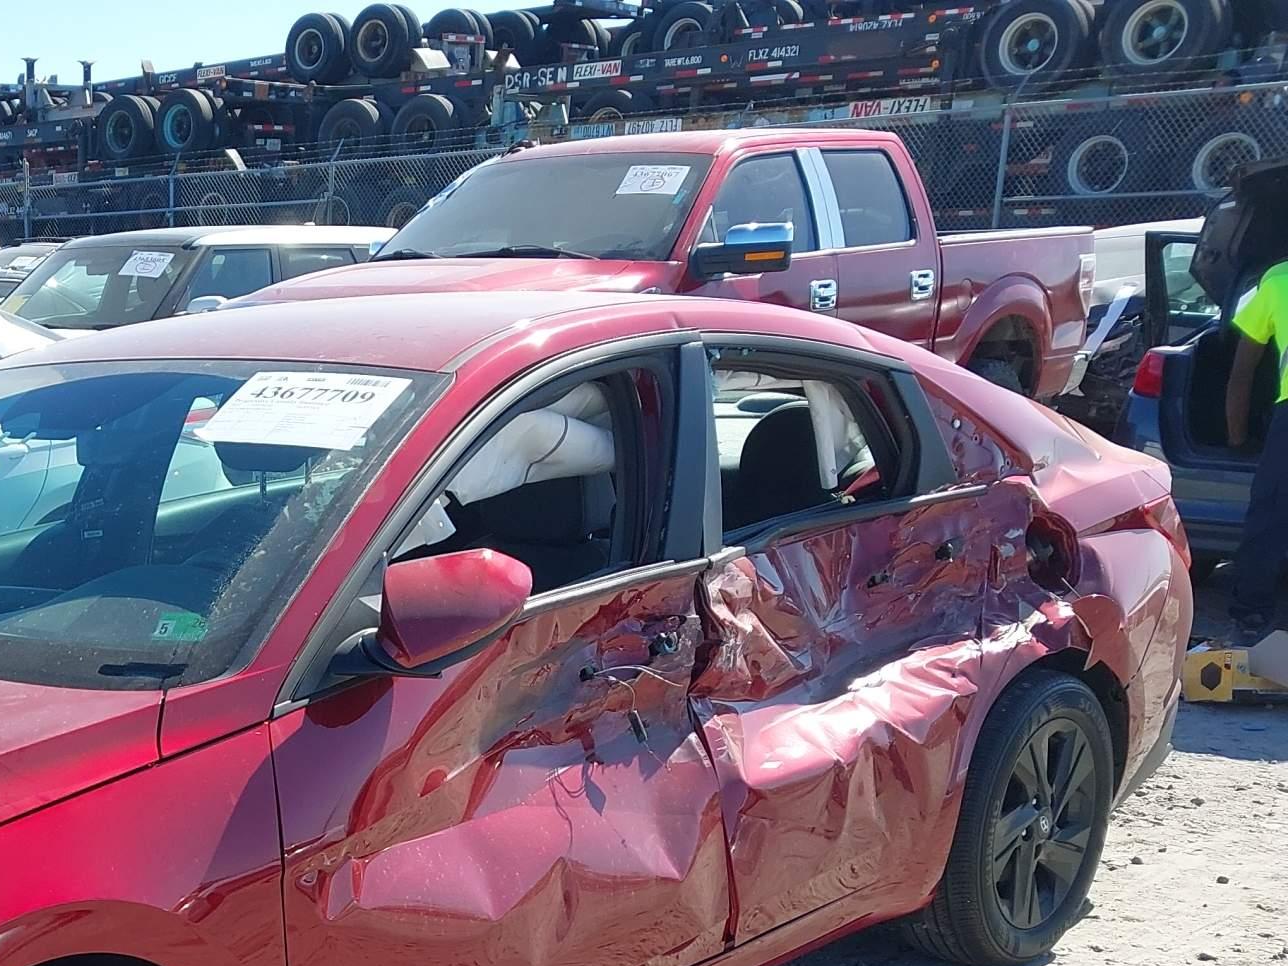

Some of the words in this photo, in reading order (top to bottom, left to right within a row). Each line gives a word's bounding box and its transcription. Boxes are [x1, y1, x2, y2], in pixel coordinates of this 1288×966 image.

[748, 49, 769, 61] FLXZ
[771, 45, 800, 58] 414321
[574, 62, 620, 78] FLEXI-VAN
[850, 98, 928, 119] FLEXI-VAN
[250, 385, 376, 404] 43677709
[159, 623, 169, 635] 5
